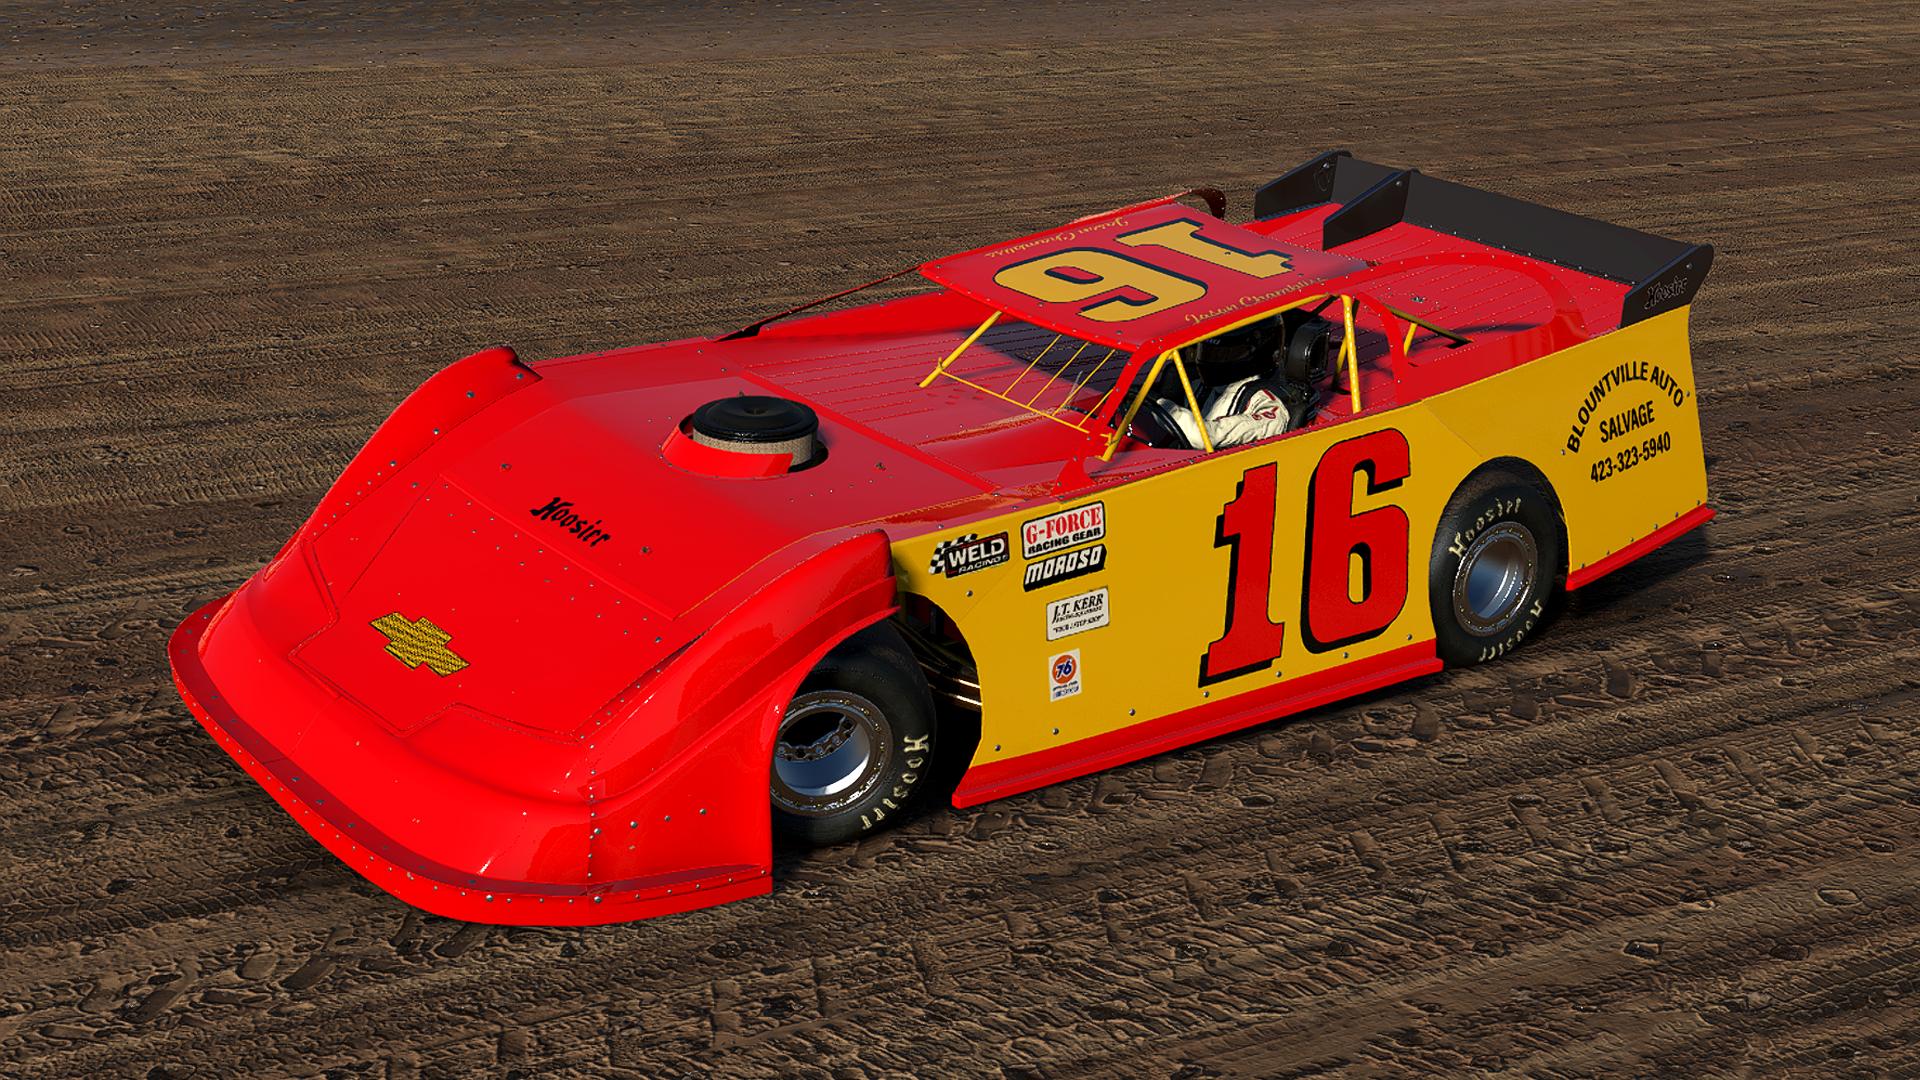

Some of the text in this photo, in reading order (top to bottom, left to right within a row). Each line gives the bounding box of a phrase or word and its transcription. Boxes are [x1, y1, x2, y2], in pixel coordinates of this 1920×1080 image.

[993, 217, 1296, 323] 16
[1567, 361, 1685, 454] BLOUNTVILLE AUTO
[1599, 400, 1656, 443] SALVAGE
[1590, 431, 1671, 483] 423-323-5940
[530, 497, 611, 547] Hoosier
[1025, 506, 1102, 544] G-FORCE
[1028, 527, 1102, 555] RACING GEAR
[948, 537, 1006, 568] WELD
[1025, 546, 1104, 586] MOROSO
[1198, 428, 1411, 688] 16
[1073, 593, 1104, 613] KERR
[1056, 658, 1073, 678] 76
